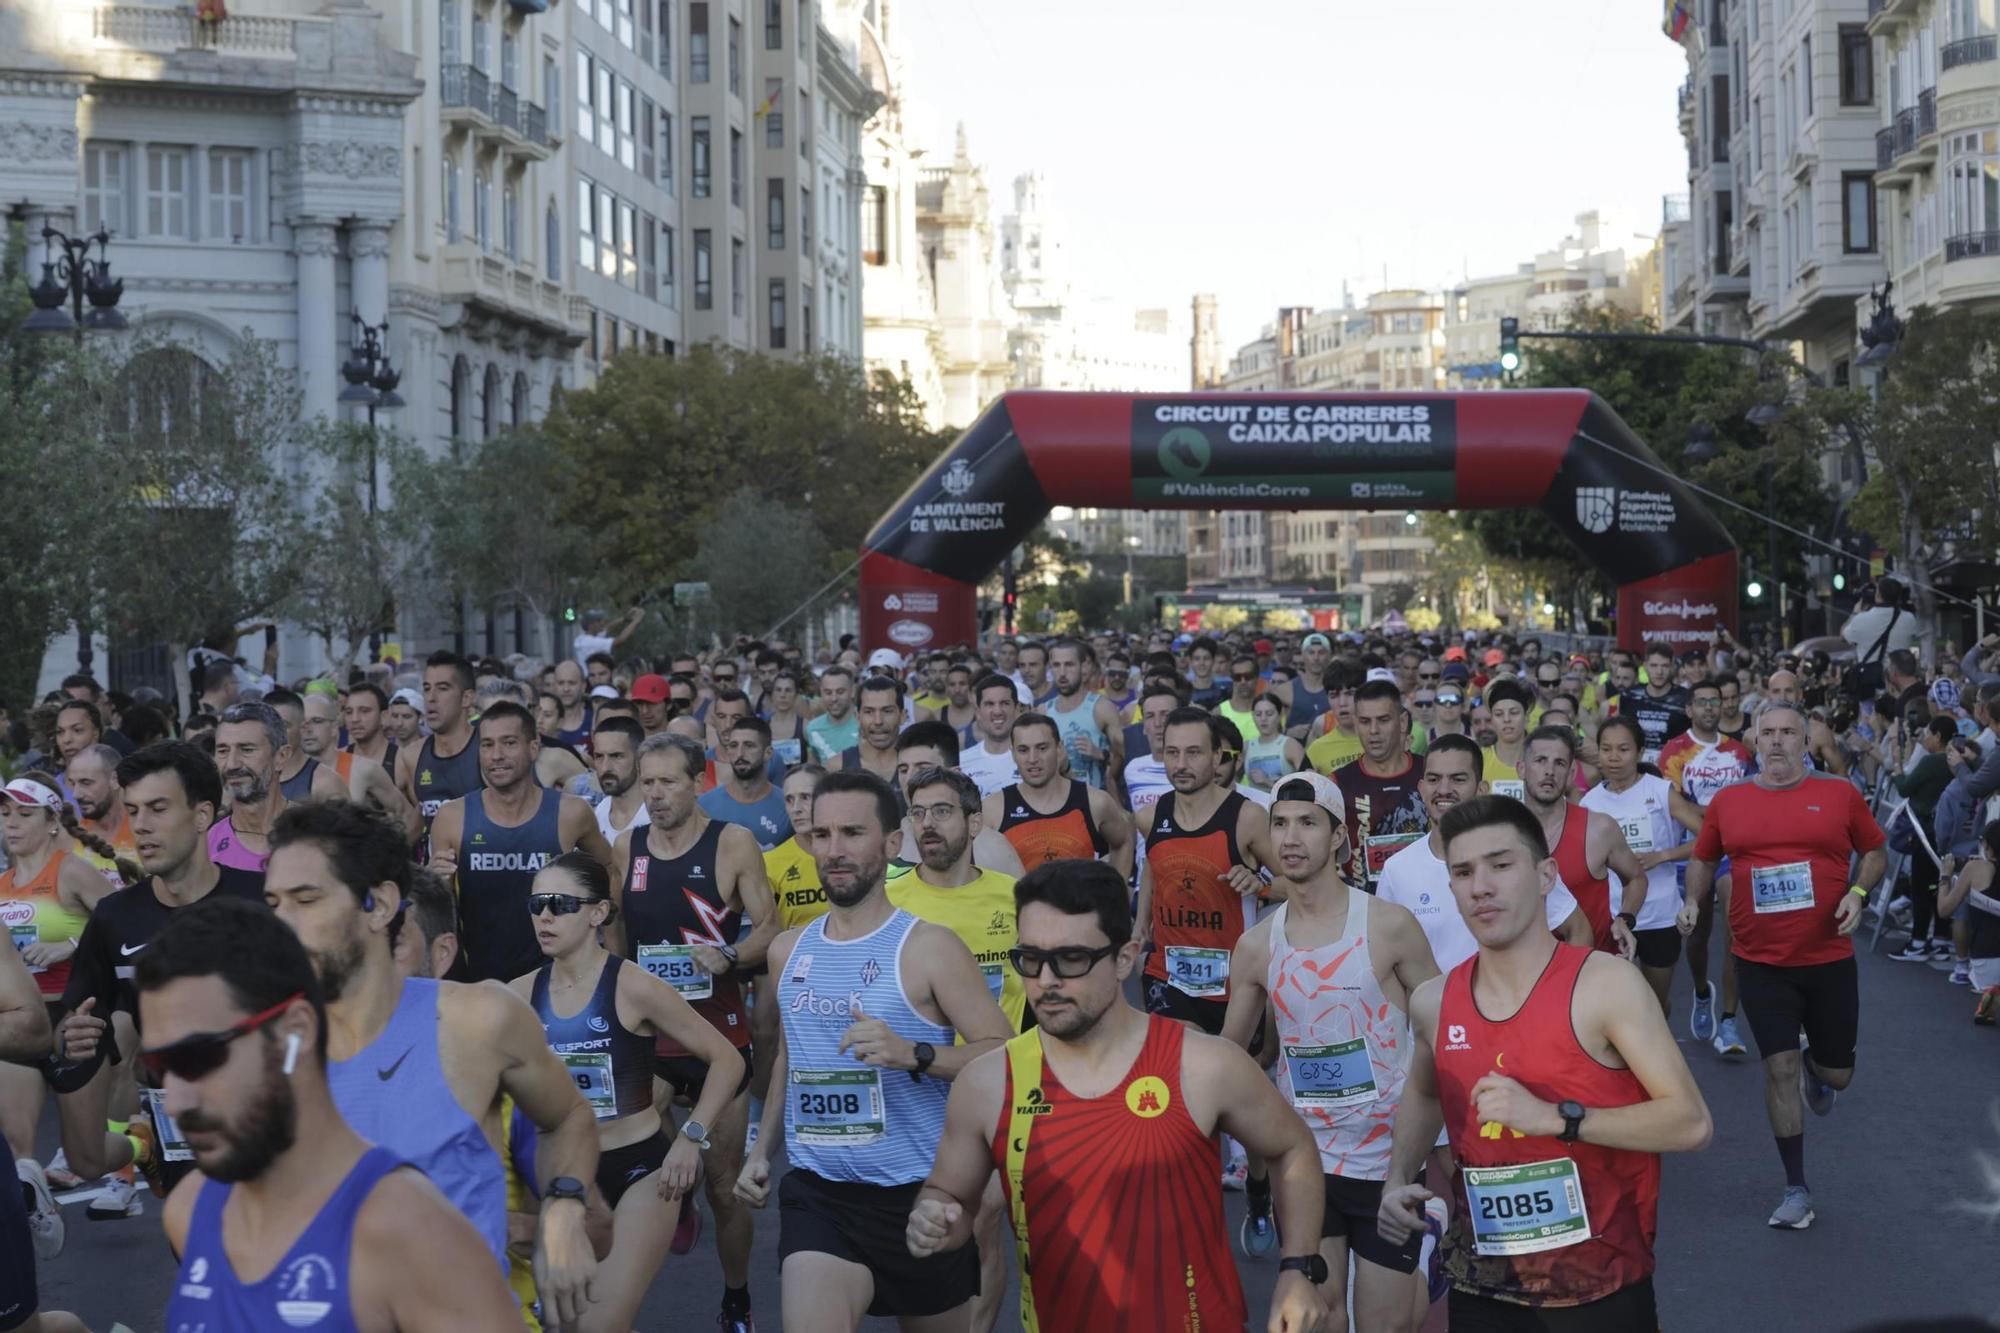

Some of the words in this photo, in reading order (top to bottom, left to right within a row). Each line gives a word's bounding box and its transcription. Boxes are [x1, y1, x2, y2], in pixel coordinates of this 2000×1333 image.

[1155, 406, 1251, 422] CIRCUIT
[1257, 406, 1290, 421] DE
[1294, 406, 1430, 422] CARRERES
[1228, 423, 1432, 442] CAIXAPOPULAR
[1163, 483, 1310, 496] #ValènciaCorre
[912, 502, 1005, 517] AJUNTAMENT
[911, 519, 929, 532] DE
[933, 516, 1005, 532] VALÈNCIA
[1620, 512, 1676, 525] Municipal
[470, 853, 546, 871] REDOLAT
[1159, 906, 1224, 931] LLÍRIA
[647, 962, 694, 978] 2253
[1300, 1062, 1344, 1080] 6852
[800, 1093, 860, 1115] 2308
[1016, 1104, 1052, 1115] VIATOR
[1479, 1190, 1554, 1219] 2085
